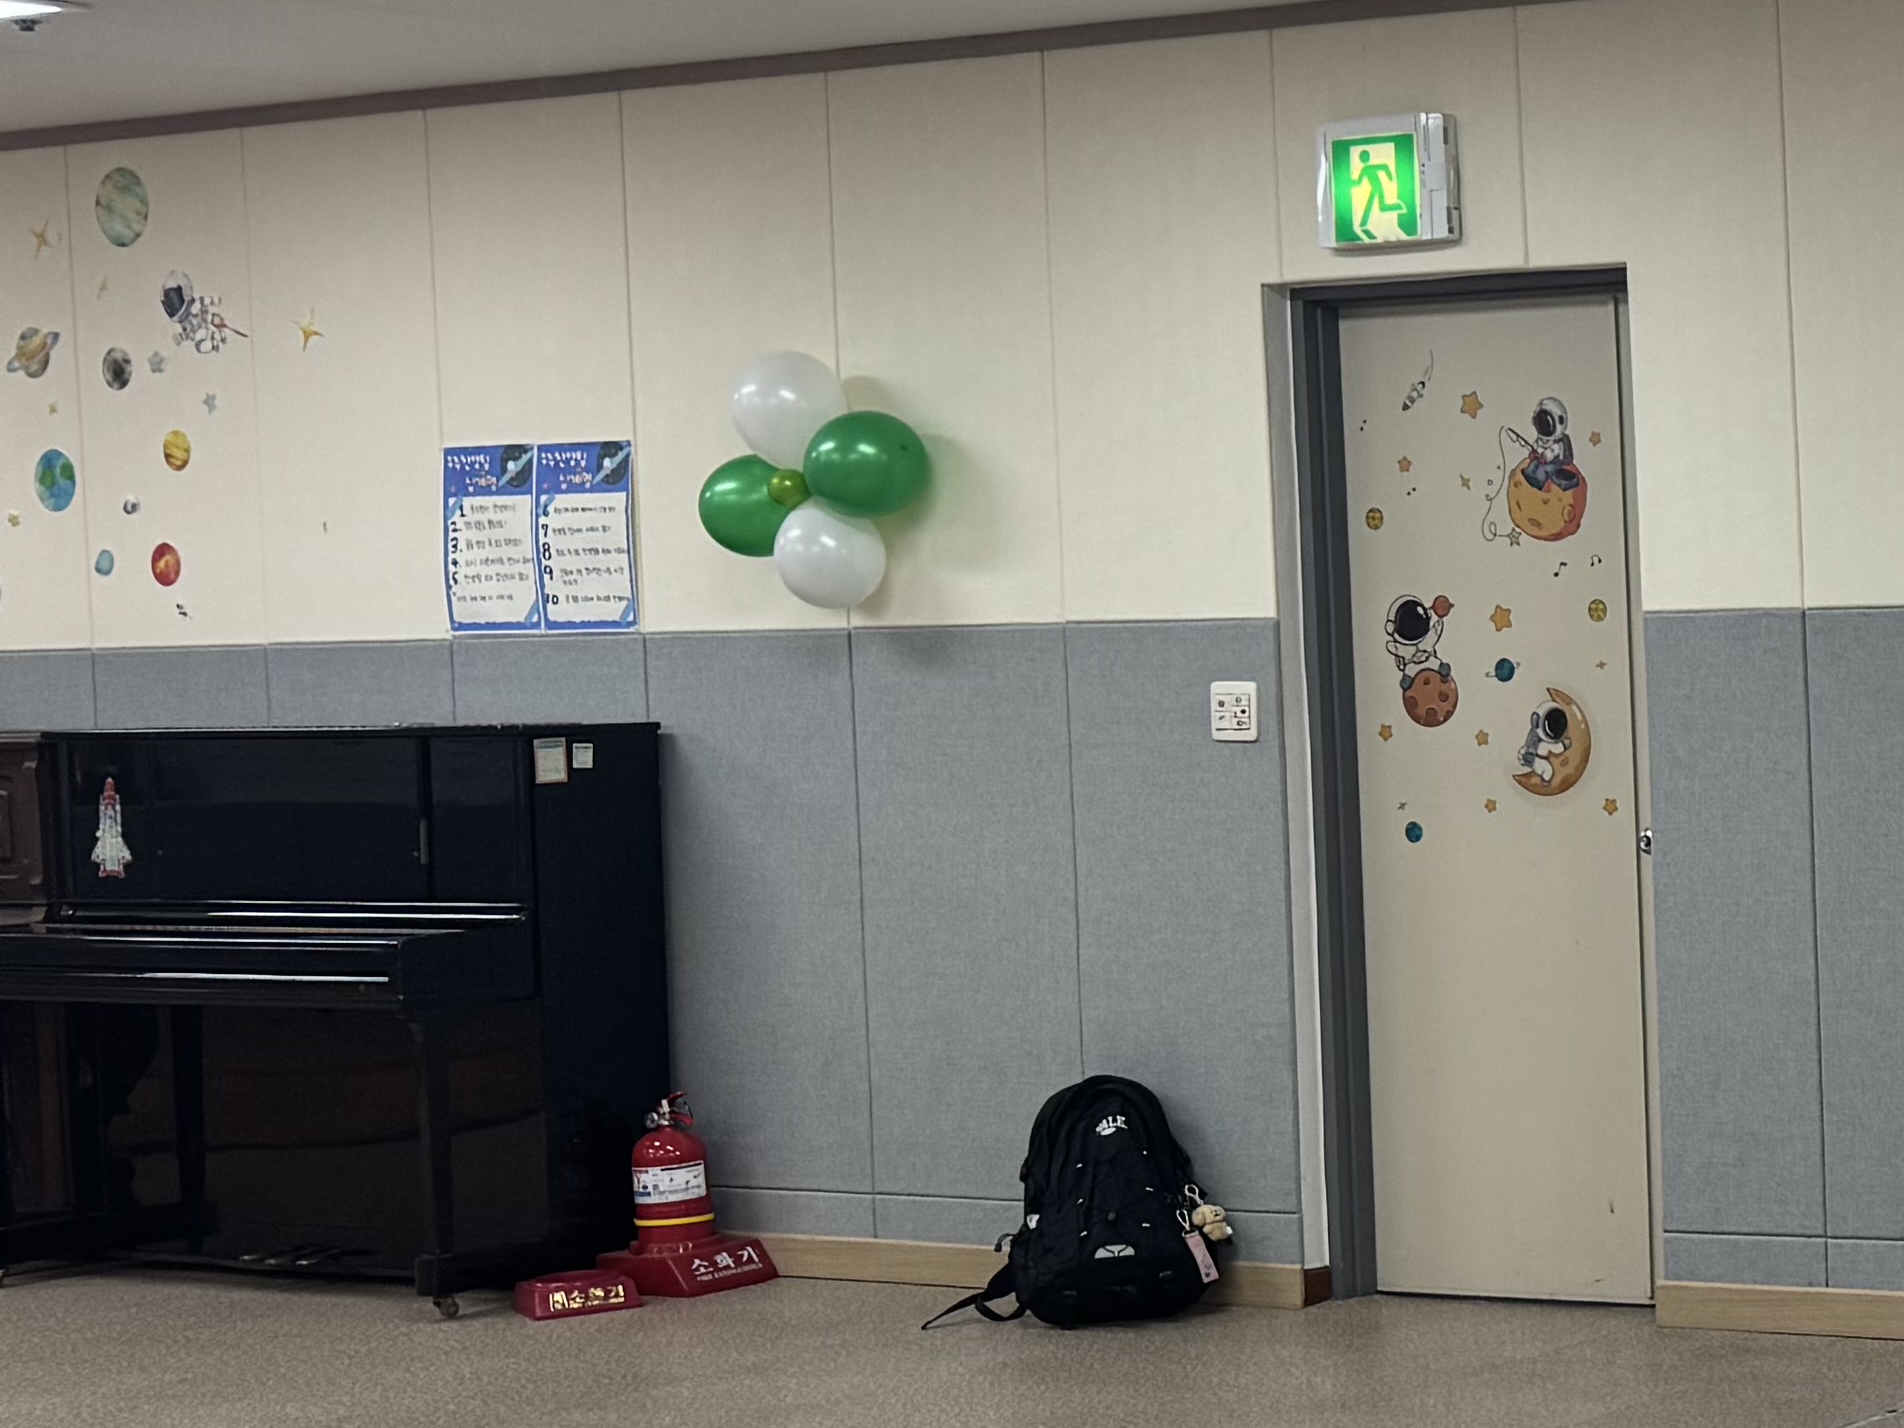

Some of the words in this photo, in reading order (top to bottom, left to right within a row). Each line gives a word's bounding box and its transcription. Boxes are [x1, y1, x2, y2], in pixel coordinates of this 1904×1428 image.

[541, 523, 549, 538] 7
[542, 541, 552, 561] 8
[543, 564, 554, 581] 9
[691, 1246, 760, 1275] 소화기
